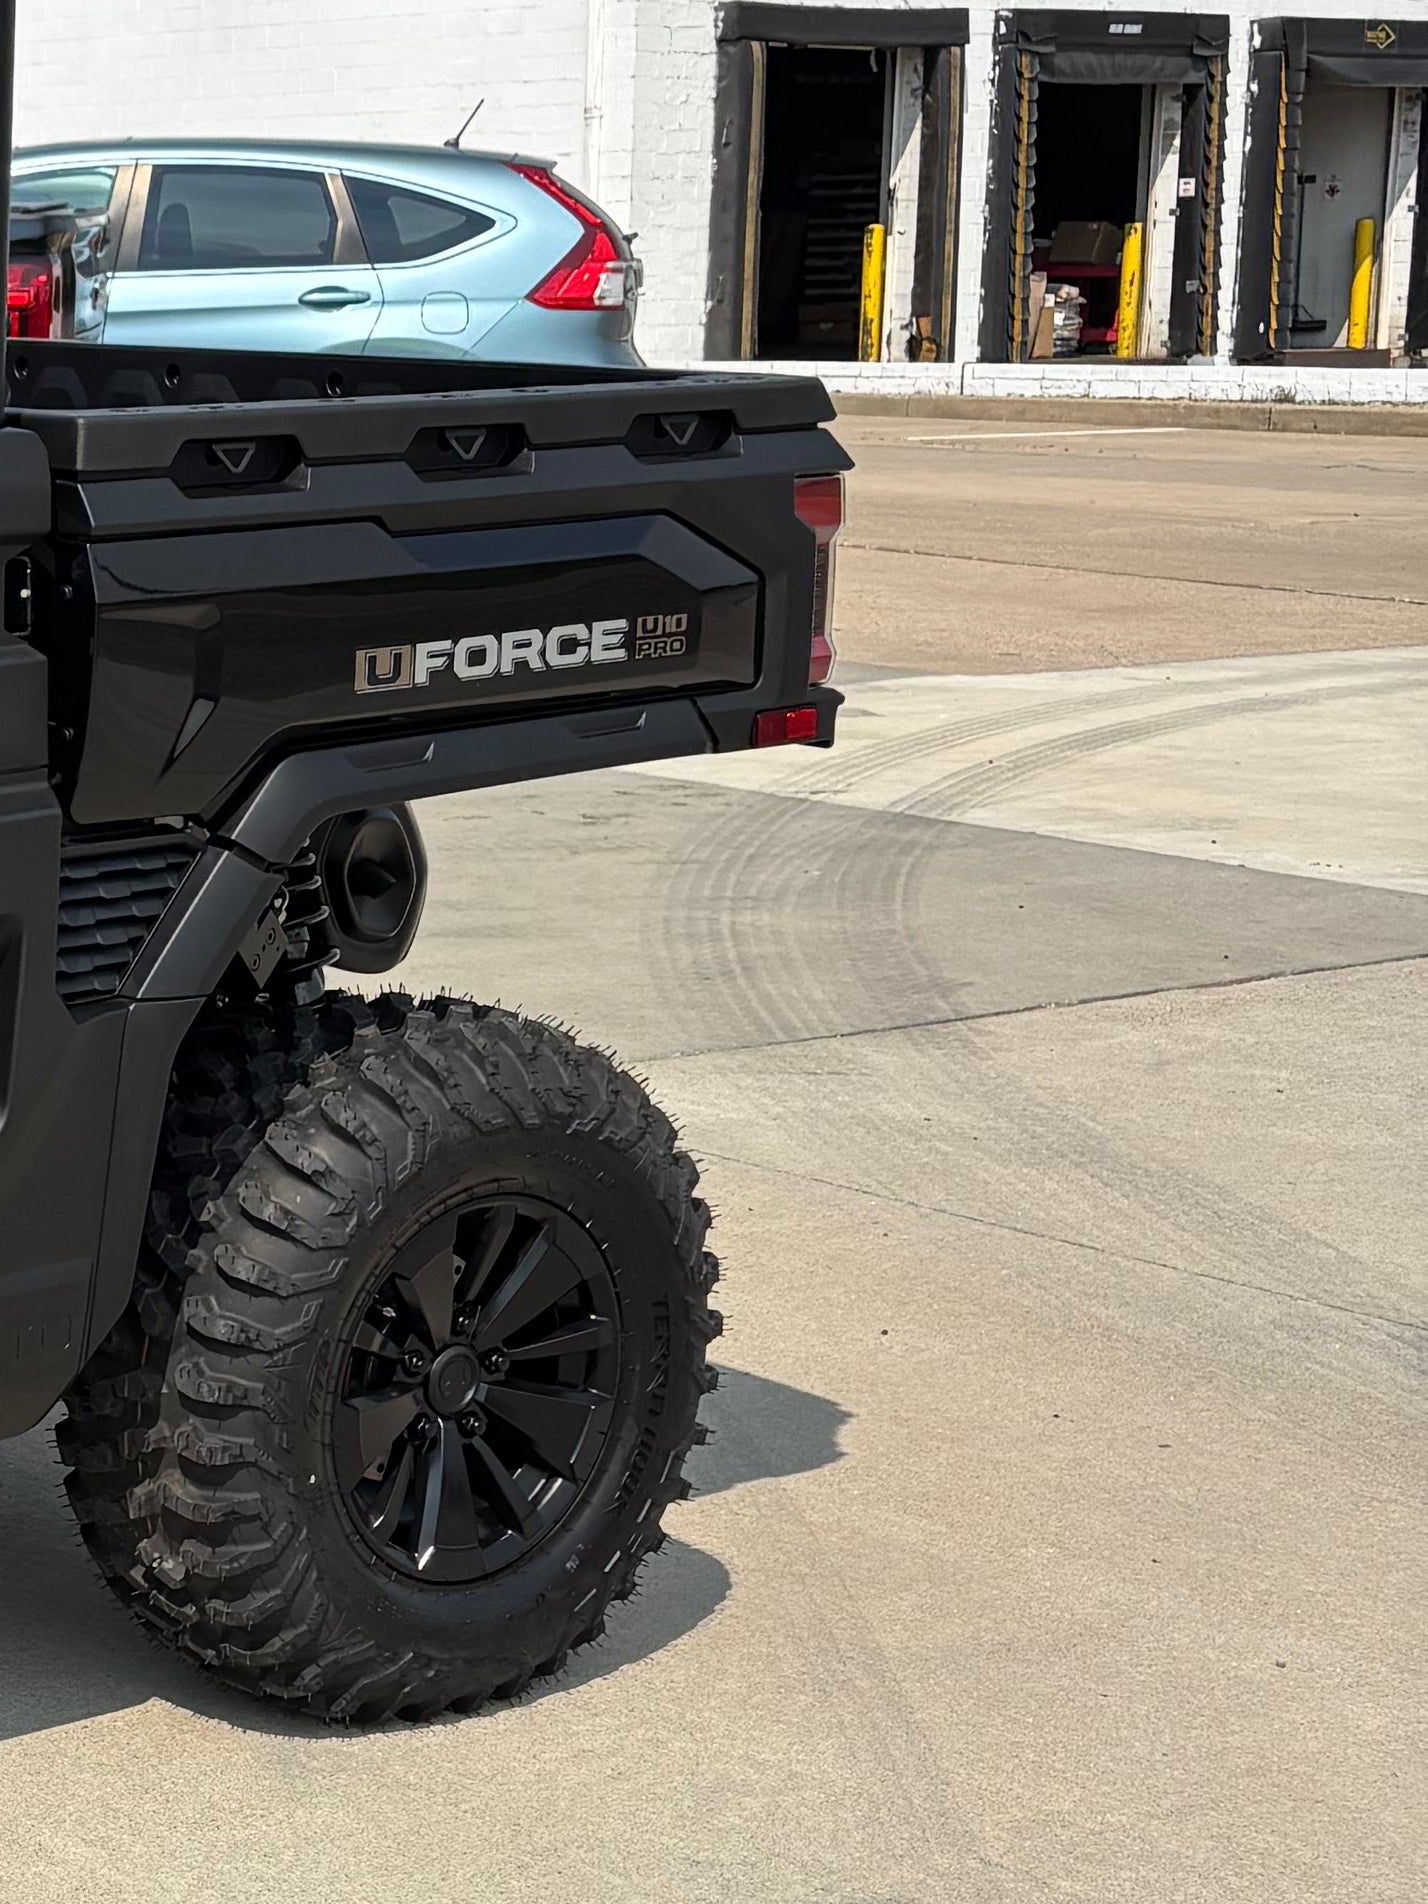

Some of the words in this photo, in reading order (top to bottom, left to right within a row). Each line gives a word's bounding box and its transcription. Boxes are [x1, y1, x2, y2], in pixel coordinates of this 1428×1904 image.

[636, 612, 688, 638] U10
[354, 617, 630, 695] UFORCE
[635, 636, 687, 659] PRO
